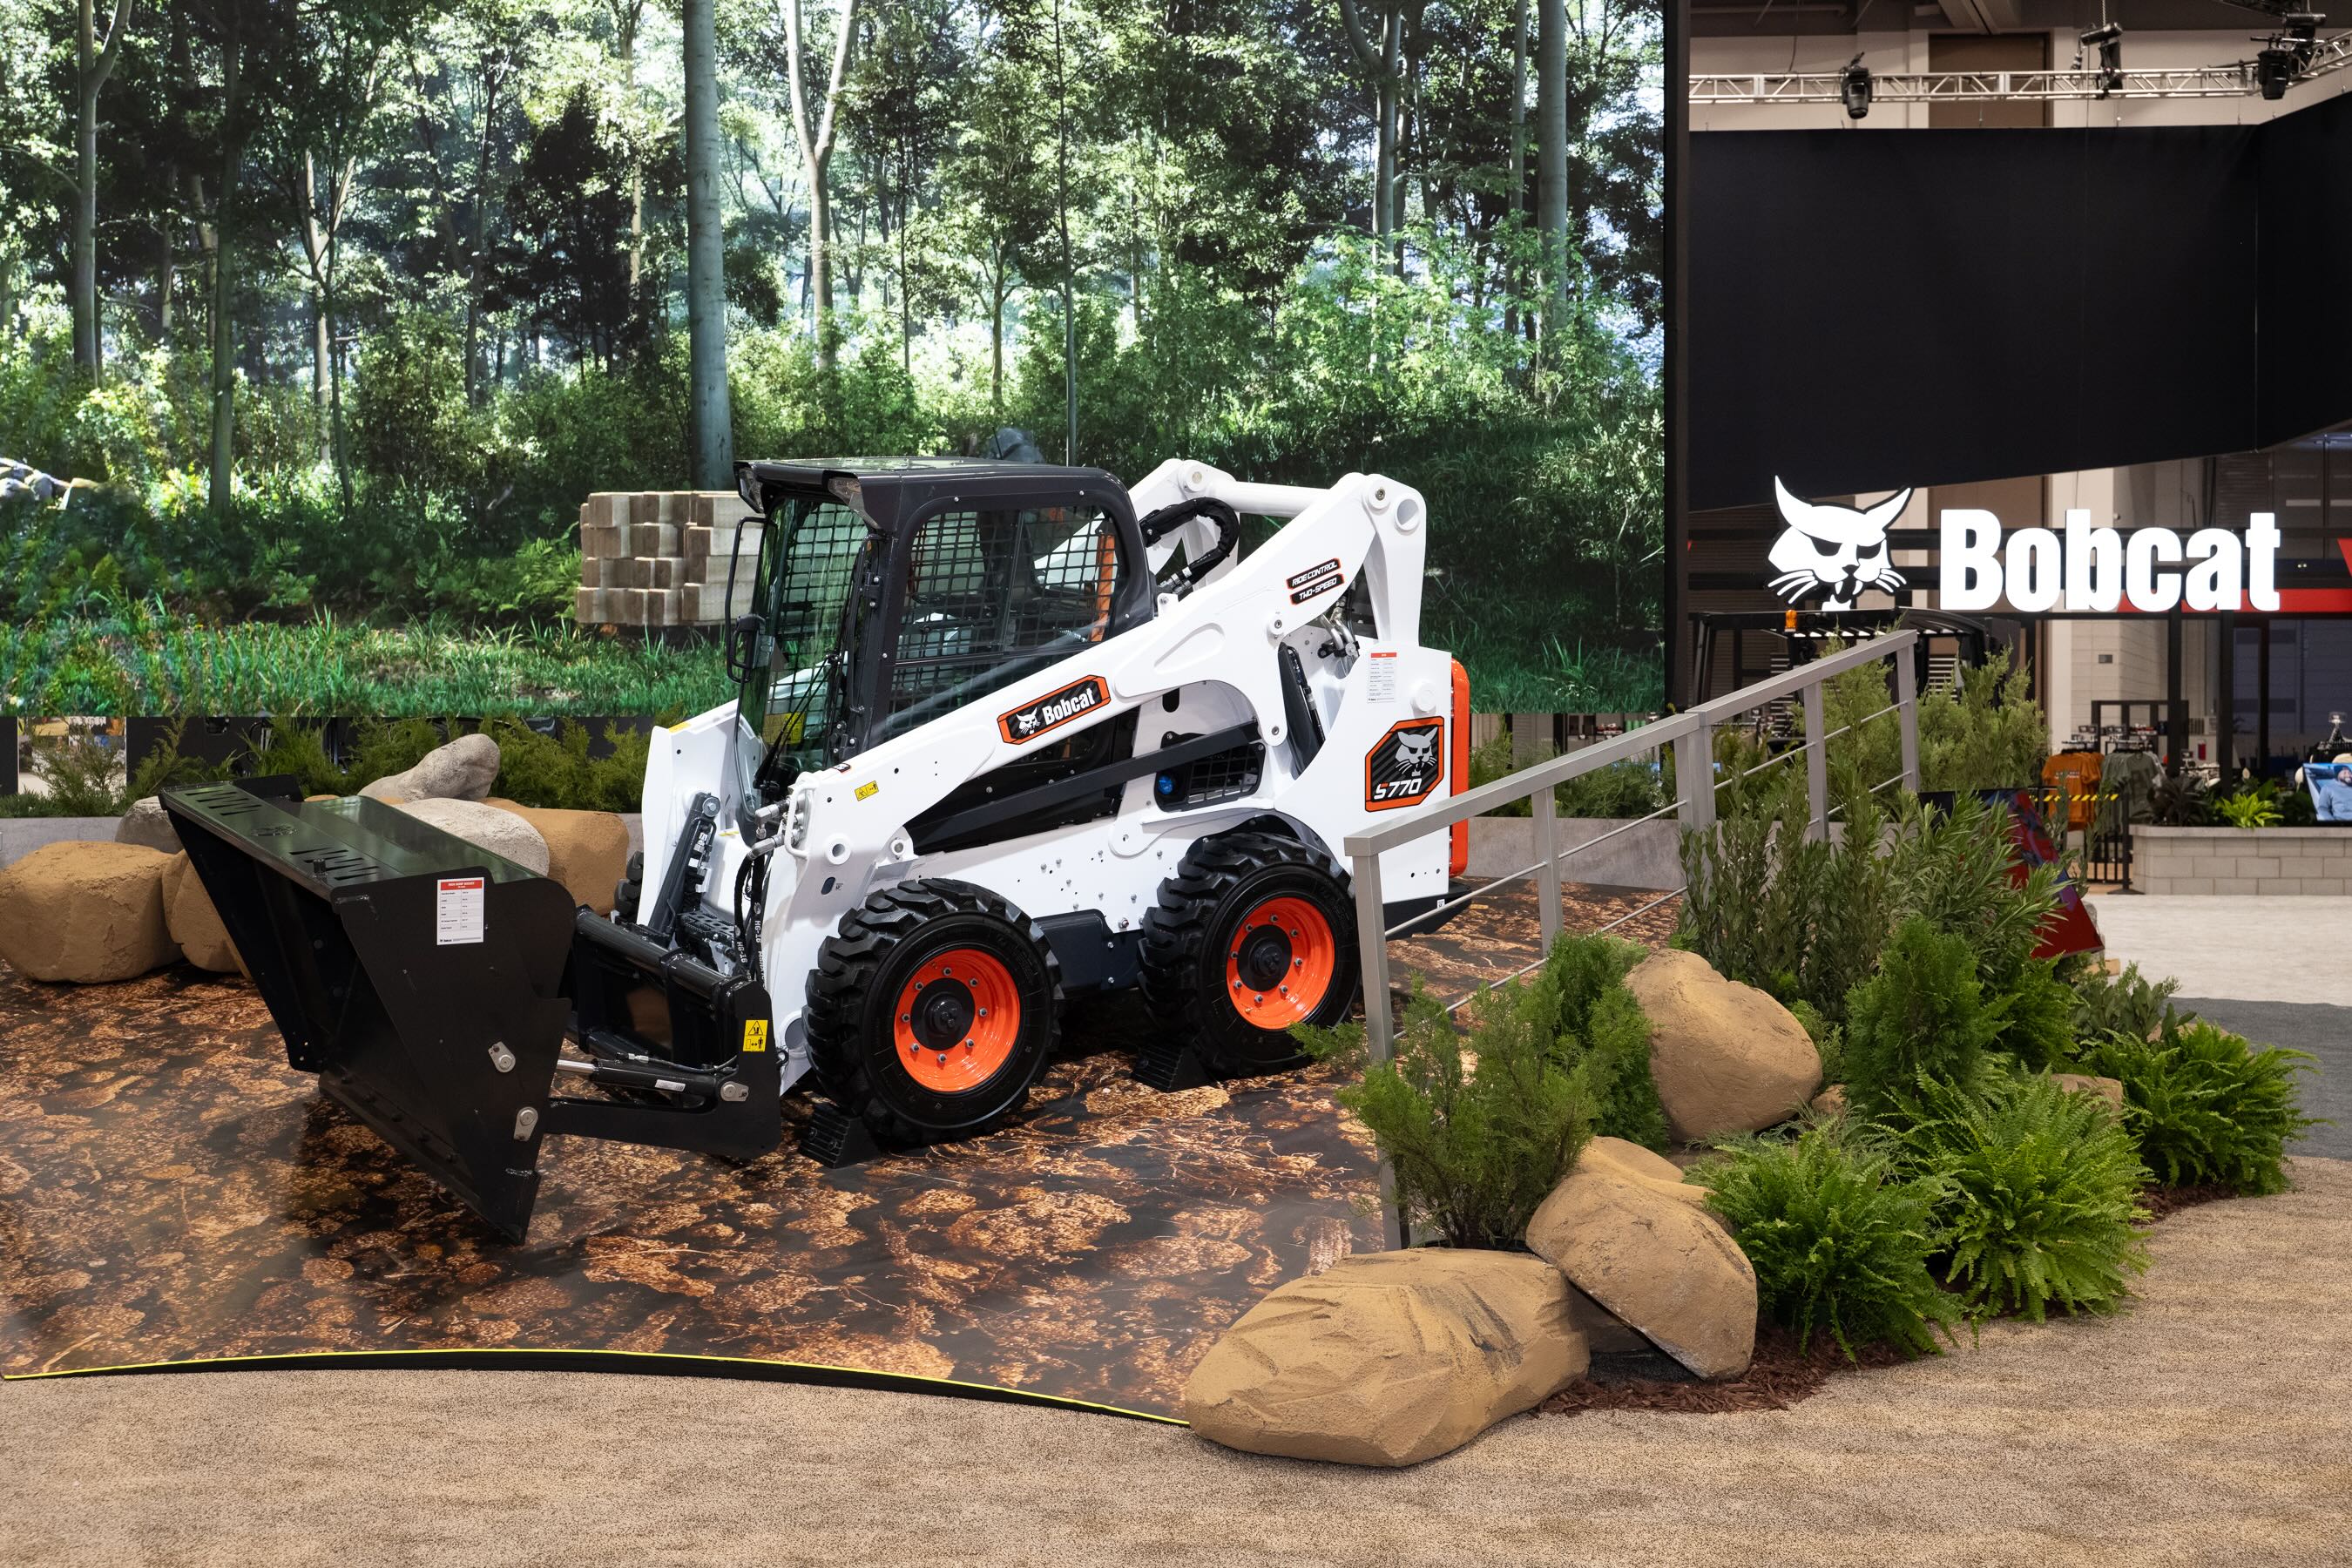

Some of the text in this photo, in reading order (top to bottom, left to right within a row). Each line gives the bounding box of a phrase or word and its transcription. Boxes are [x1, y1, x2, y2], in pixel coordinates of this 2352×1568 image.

[1940, 509, 2281, 612] Bobcat
[1292, 562, 1337, 586] RIDE CONTROL
[1299, 578, 1336, 599] TWO-SPEED
[1042, 687, 1096, 726] Bobcat
[1374, 778, 1422, 800] S770
[737, 942, 747, 963] HG-16
